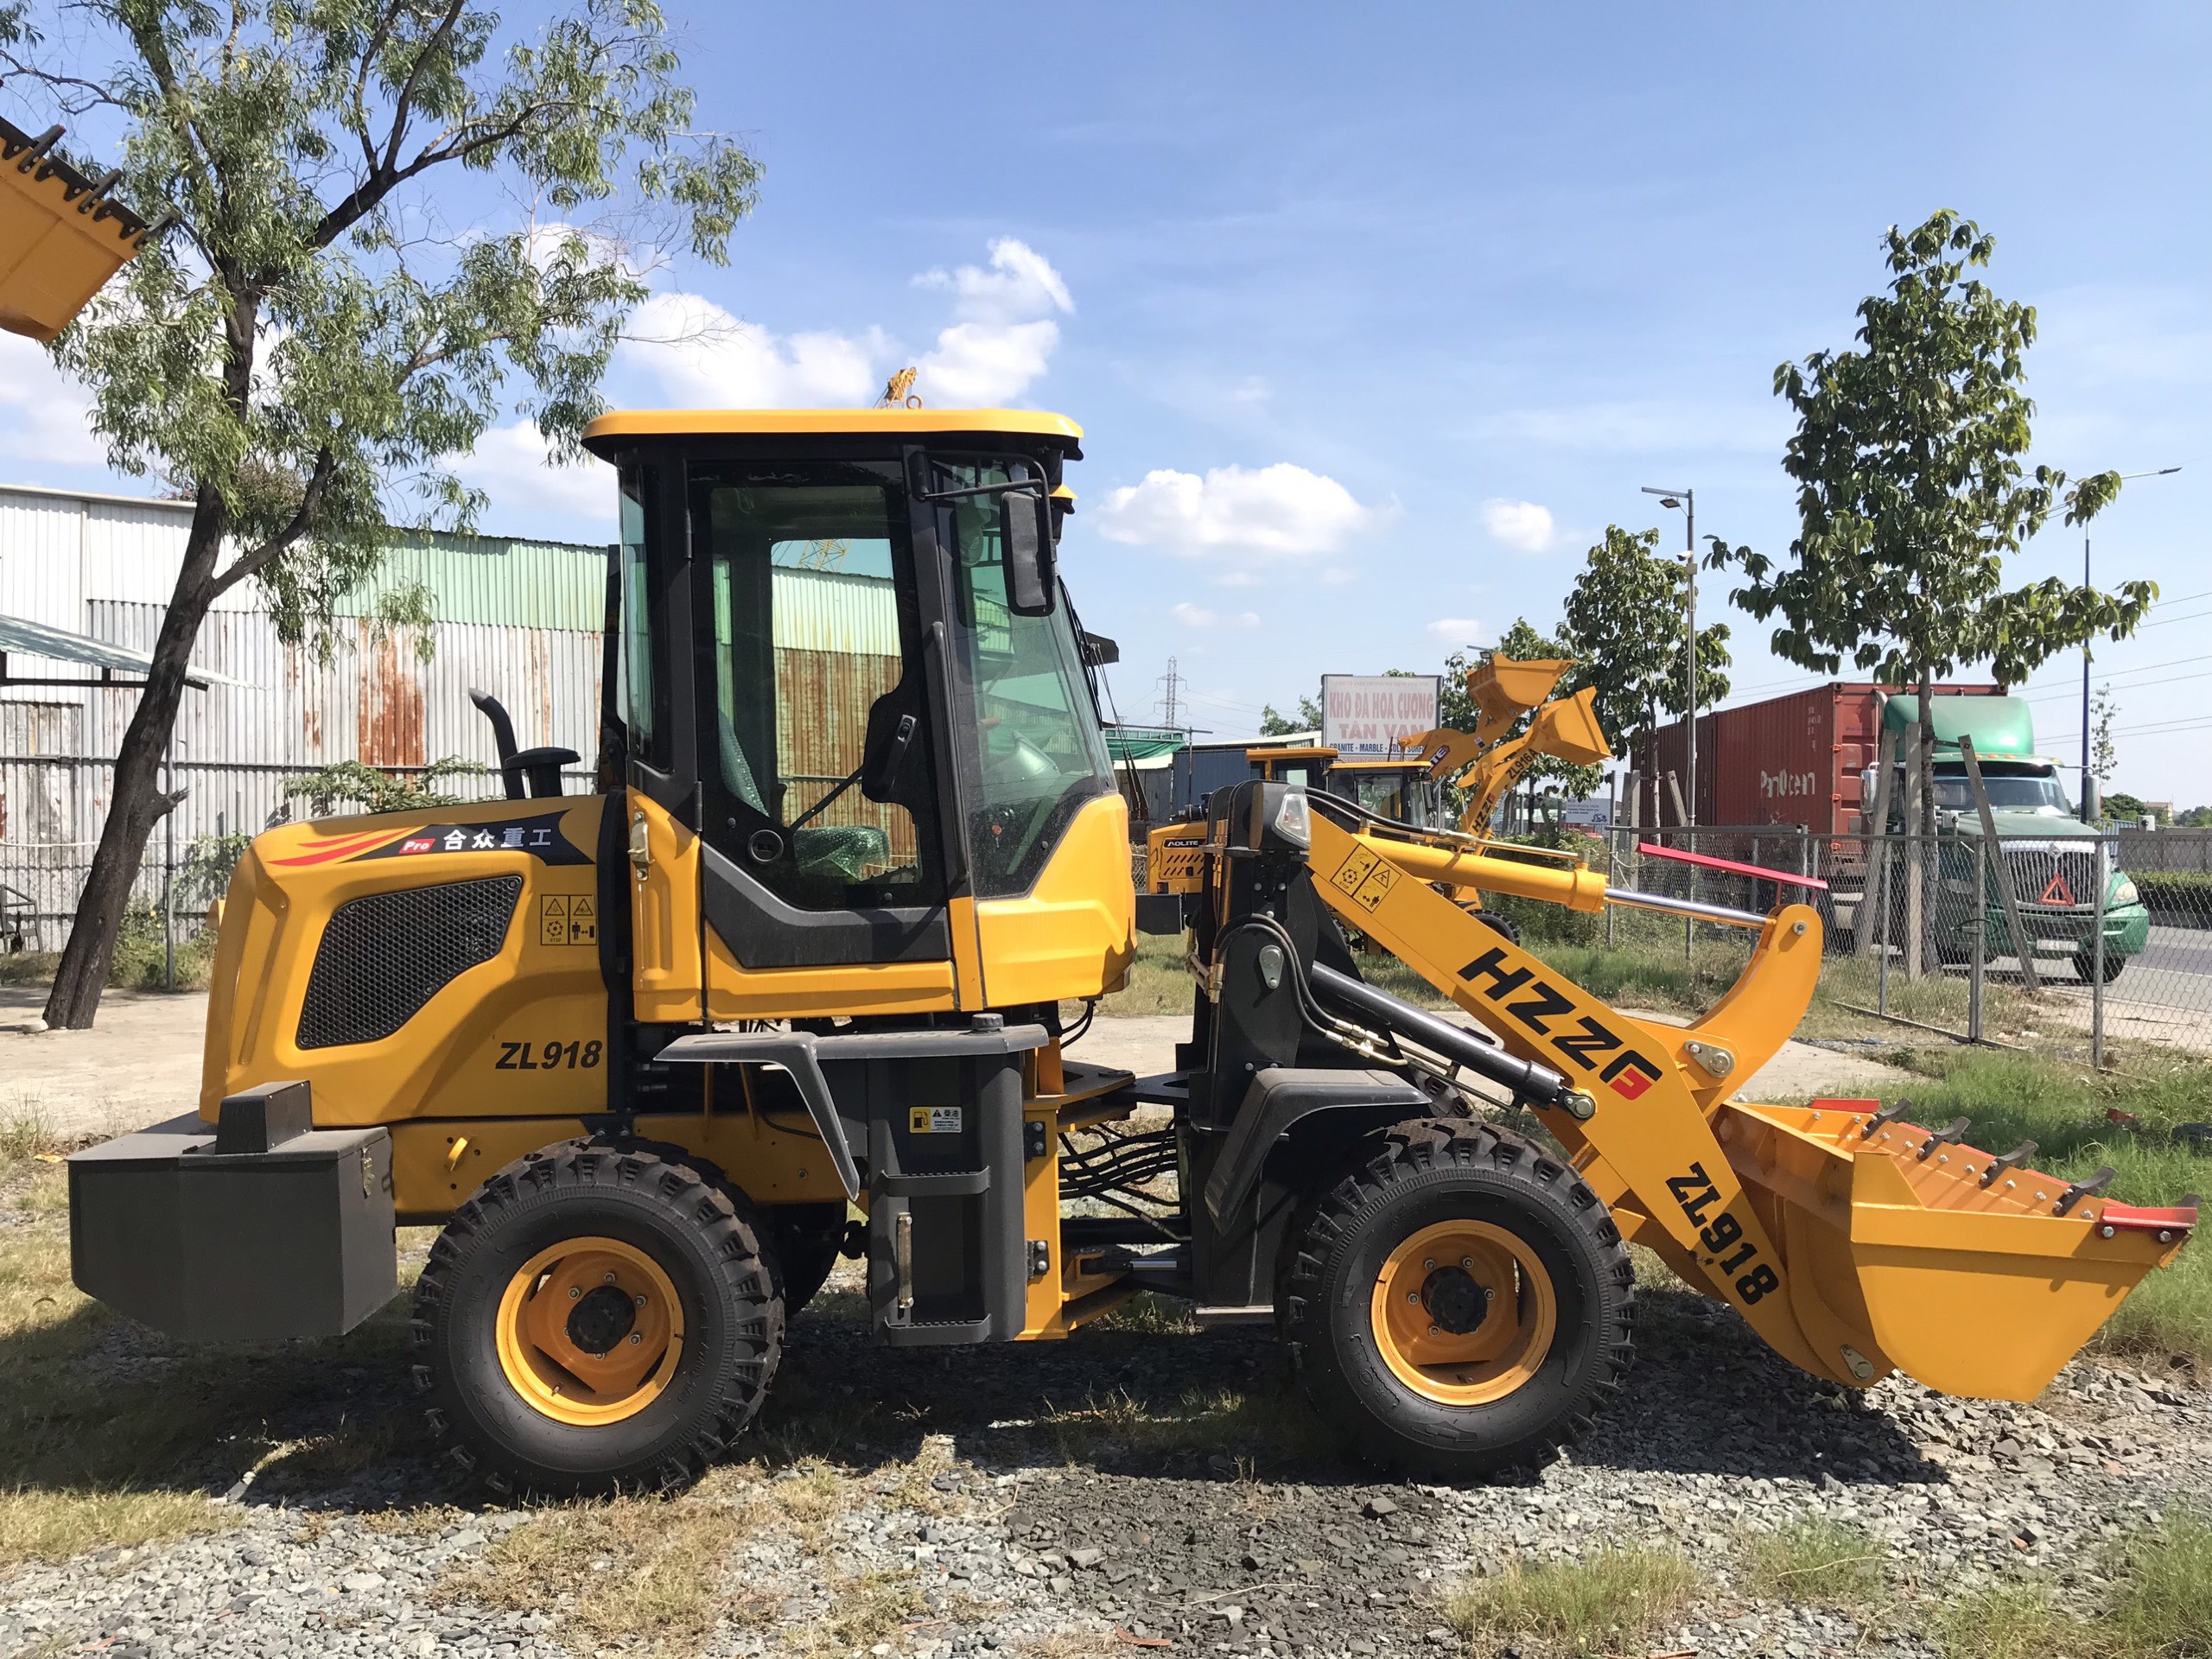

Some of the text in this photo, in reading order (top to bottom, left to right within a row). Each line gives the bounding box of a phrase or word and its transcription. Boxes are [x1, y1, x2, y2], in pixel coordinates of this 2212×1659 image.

[1330, 692, 1351, 718] KHO
[1373, 693, 1394, 719] HOA
[1339, 721, 1377, 739] TÂN
[1506, 748, 1539, 779] ZL916A
[403, 827, 552, 851] Pro 合众重工
[1338, 880, 1350, 890] STOP
[495, 1040, 603, 1069] ZL918
[1665, 1161, 1779, 1306] ZL918
